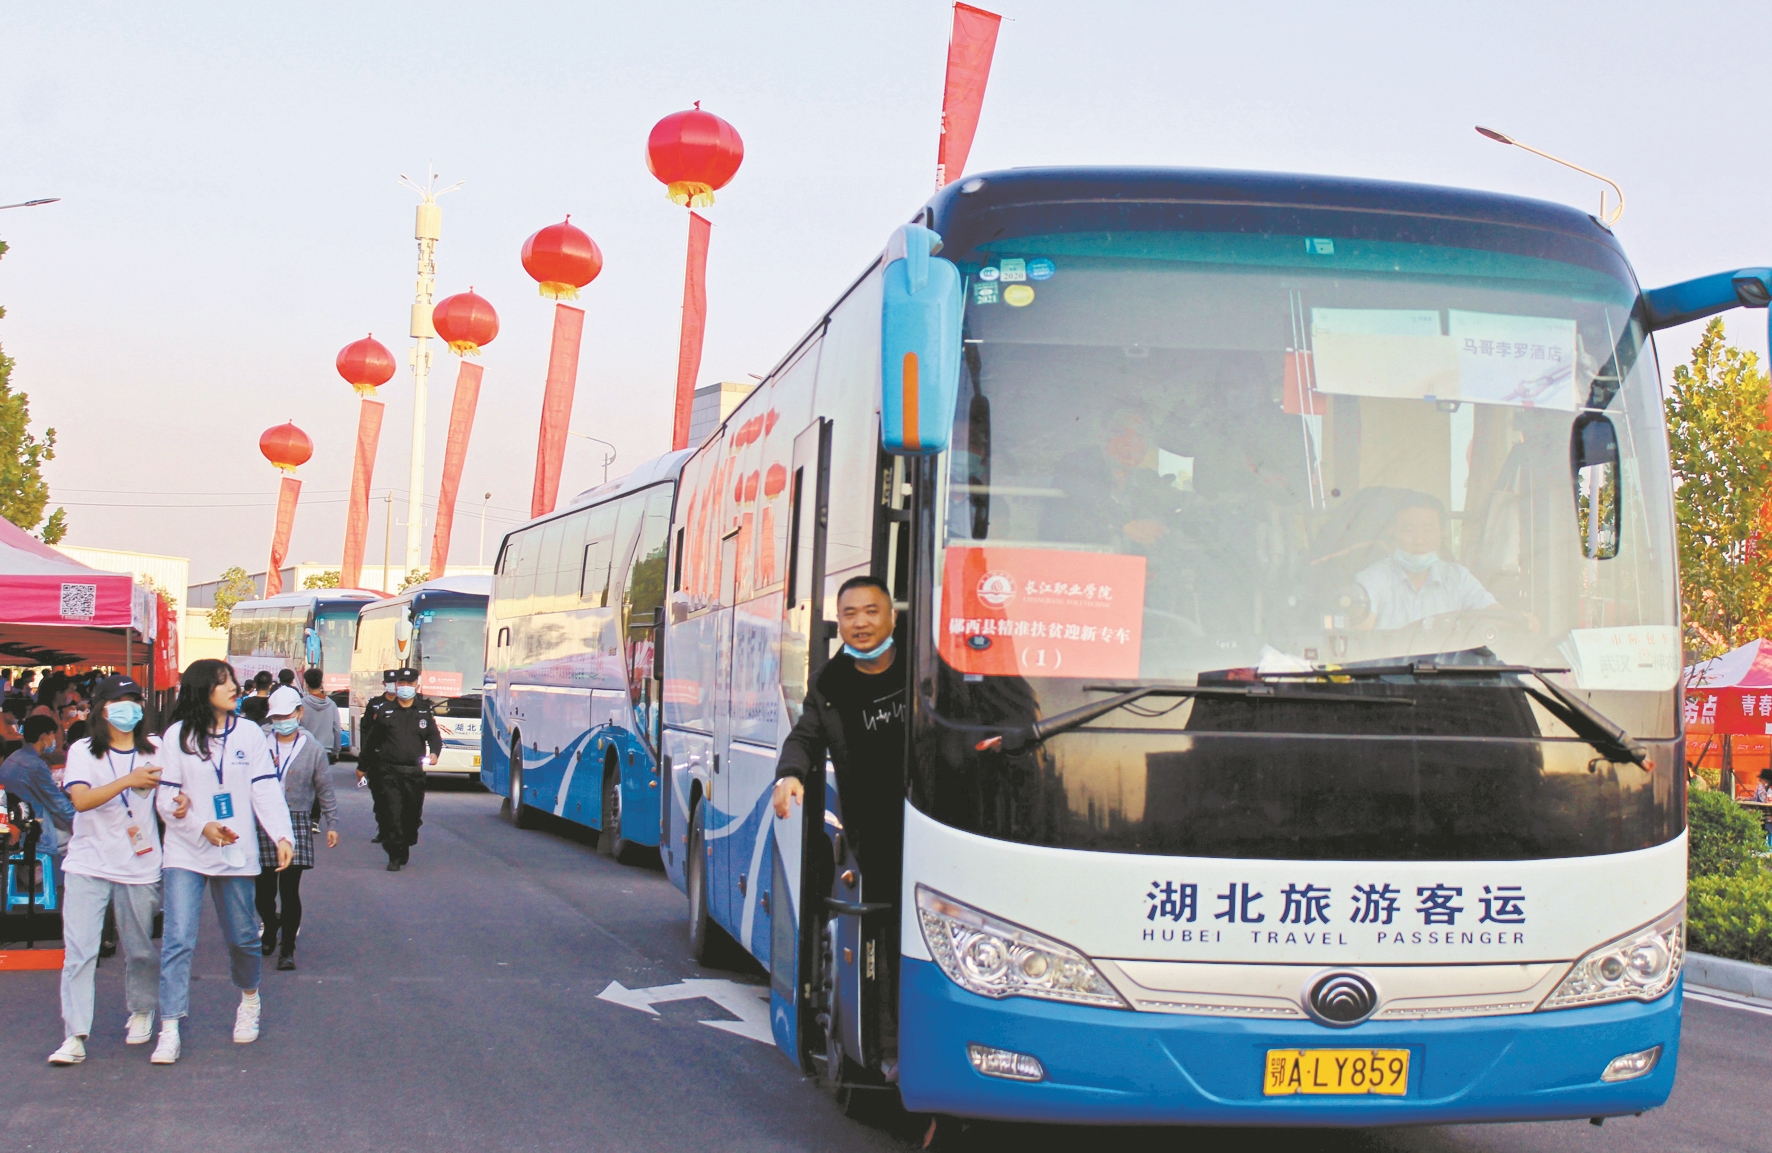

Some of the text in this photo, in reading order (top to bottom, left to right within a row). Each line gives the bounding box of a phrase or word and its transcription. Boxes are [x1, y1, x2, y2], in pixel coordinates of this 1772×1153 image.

[1003, 272, 1024, 280] 2020
[977, 294, 997, 304] 2021
[1024, 579, 1113, 601] 长江职业学院
[1741, 694, 1772, 717] 青春
[455, 723, 482, 732] 湖北
[1146, 880, 1526, 926] 湖北旅游客运
[1143, 929, 1526, 945] HUBEI TRAVEL PASSENGER
